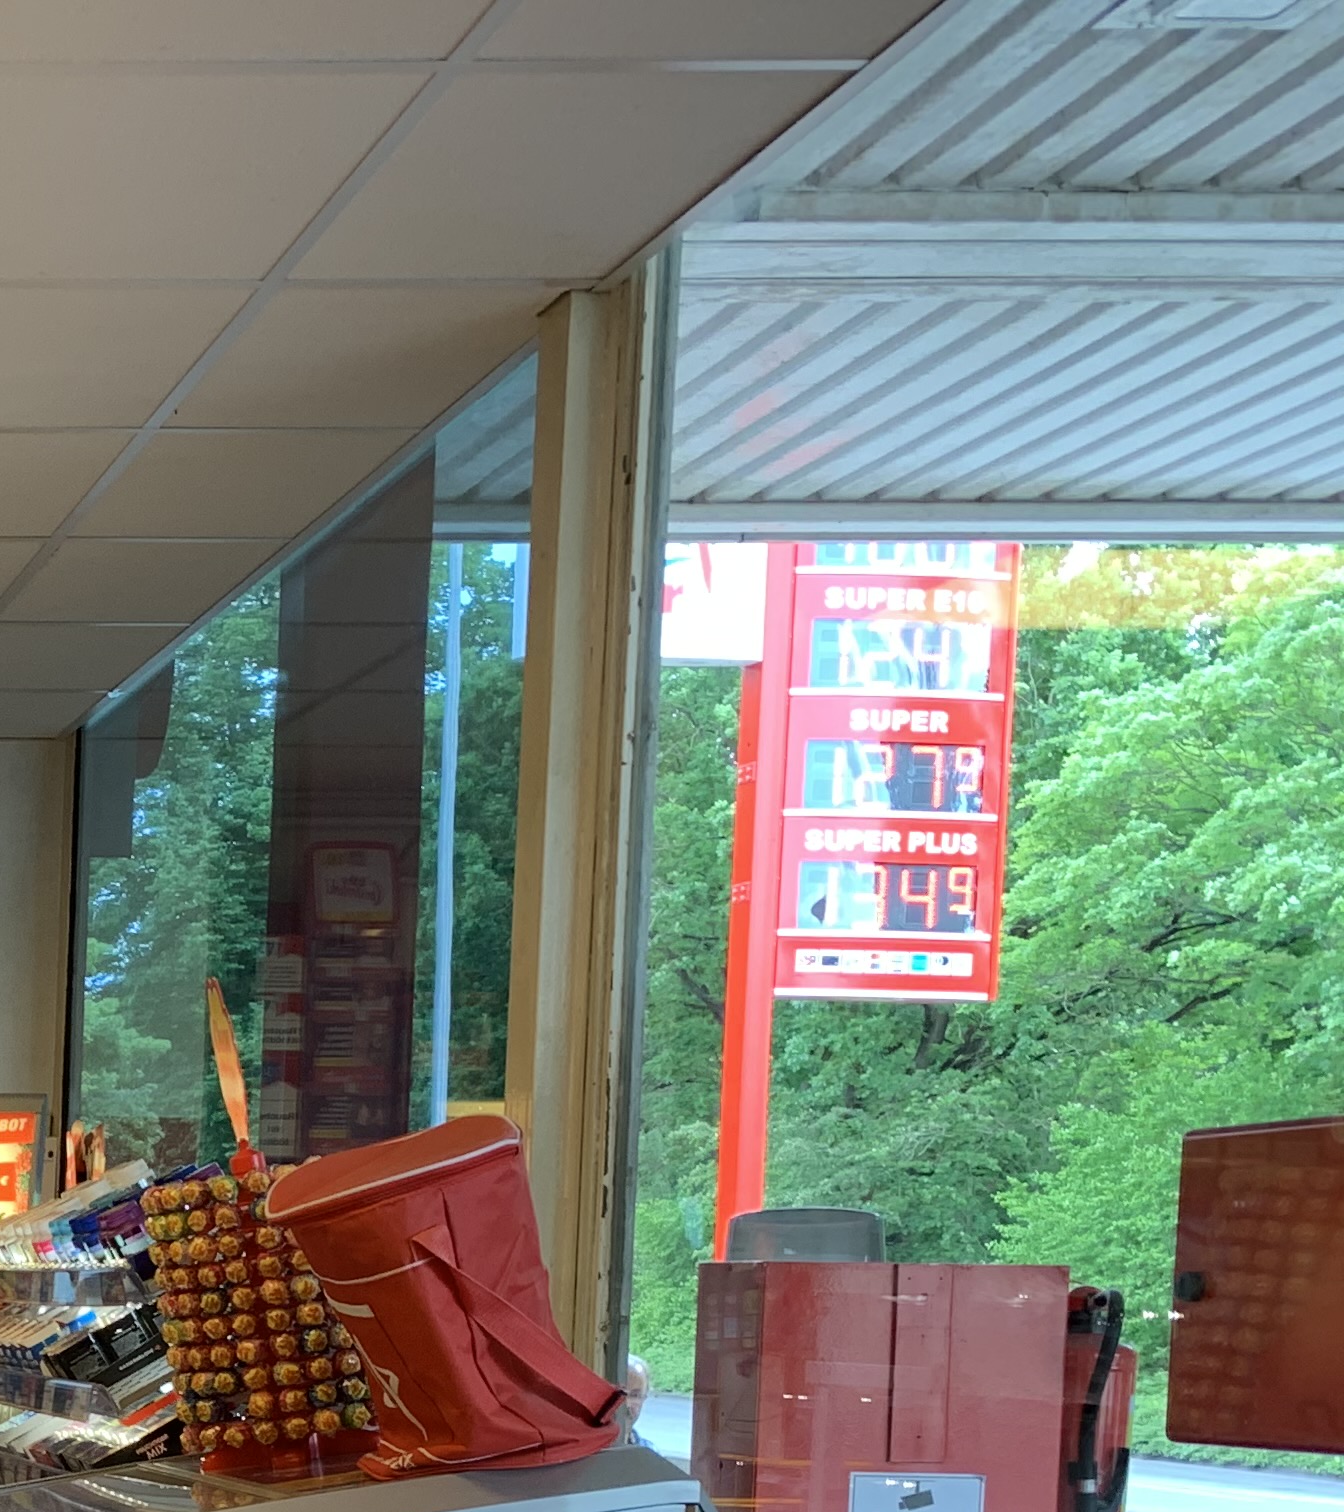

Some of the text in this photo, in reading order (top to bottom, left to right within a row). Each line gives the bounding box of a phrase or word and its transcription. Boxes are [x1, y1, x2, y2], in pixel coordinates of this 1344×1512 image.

[824, 587, 926, 611] SUPER
[849, 709, 948, 733] SUPER
[804, 829, 979, 857] SUPER PLUS
[0, 1175, 9, 1186] €
